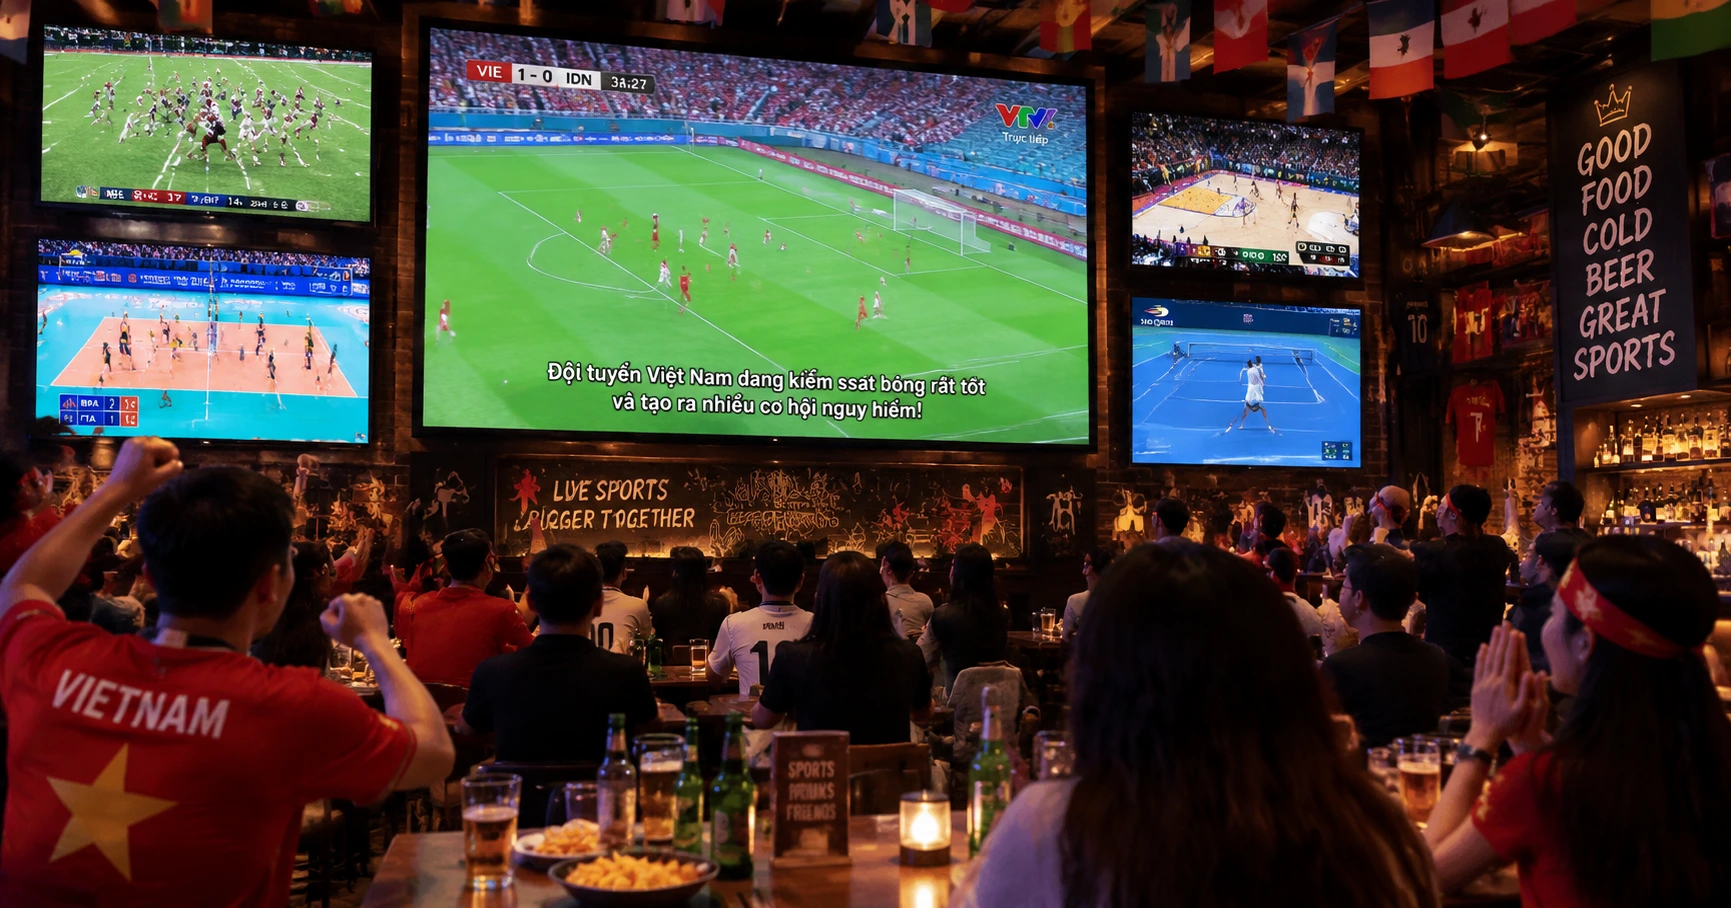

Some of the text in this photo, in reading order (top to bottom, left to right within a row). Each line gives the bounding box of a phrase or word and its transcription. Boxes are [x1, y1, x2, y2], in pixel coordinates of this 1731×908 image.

[476, 64, 503, 79] VIE
[566, 72, 592, 86] IDN
[1577, 122, 1652, 176] GOOD
[1581, 164, 1652, 216] FOOD
[1583, 207, 1653, 255] COLD
[1586, 249, 1655, 297] BEER
[1407, 313, 1428, 344] 10
[1579, 288, 1667, 340] GREAT
[547, 361, 582, 386] Đội
[647, 365, 685, 388] Việt
[690, 368, 733, 386] Nam
[1573, 330, 1676, 381] SPORTS
[640, 393, 672, 415] tạo
[677, 397, 697, 412] ra
[788, 397, 816, 419] hội
[822, 402, 868, 421] nguy
[595, 478, 670, 502] SPORTS
[52, 668, 231, 740] VIETNAM
[788, 760, 836, 779] SPORTS
